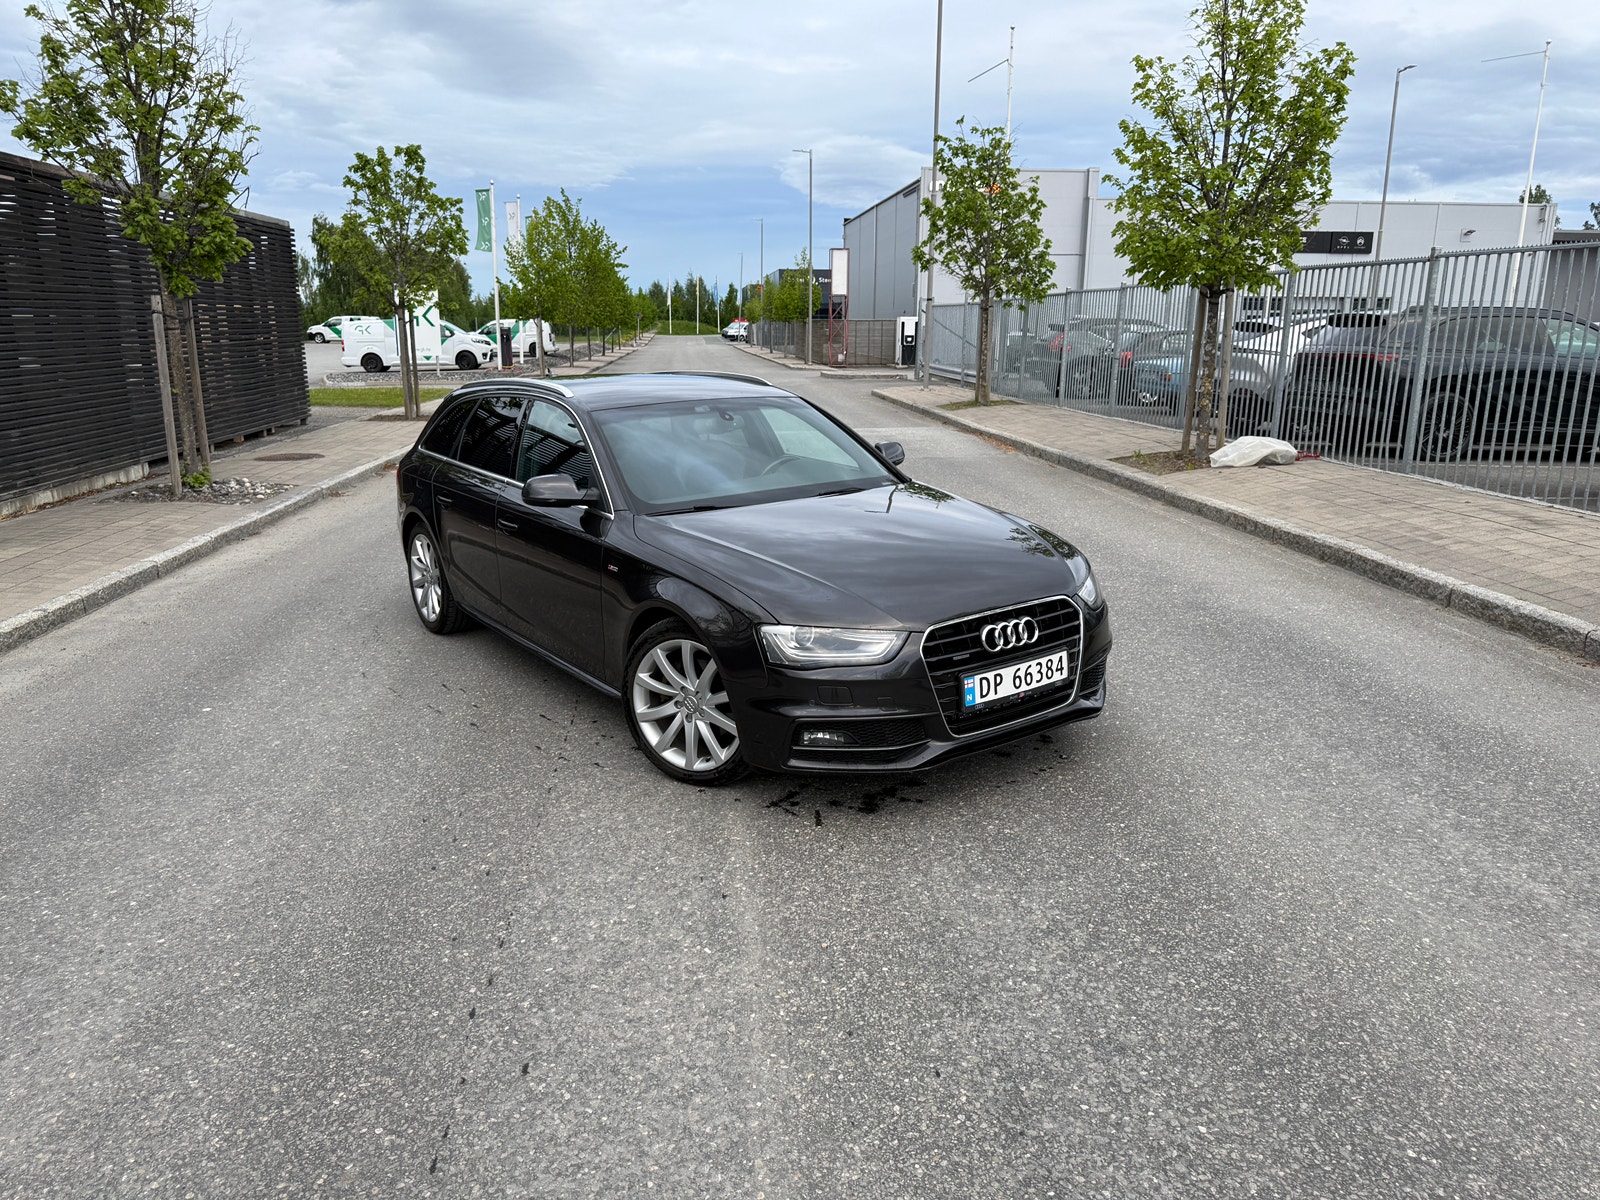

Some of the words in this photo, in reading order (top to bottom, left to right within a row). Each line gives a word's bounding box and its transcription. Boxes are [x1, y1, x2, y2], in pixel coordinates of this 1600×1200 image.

[354, 325, 371, 335] GK
[979, 672, 1004, 699] DP
[1012, 655, 1065, 690] 66384
[966, 693, 973, 702] N
